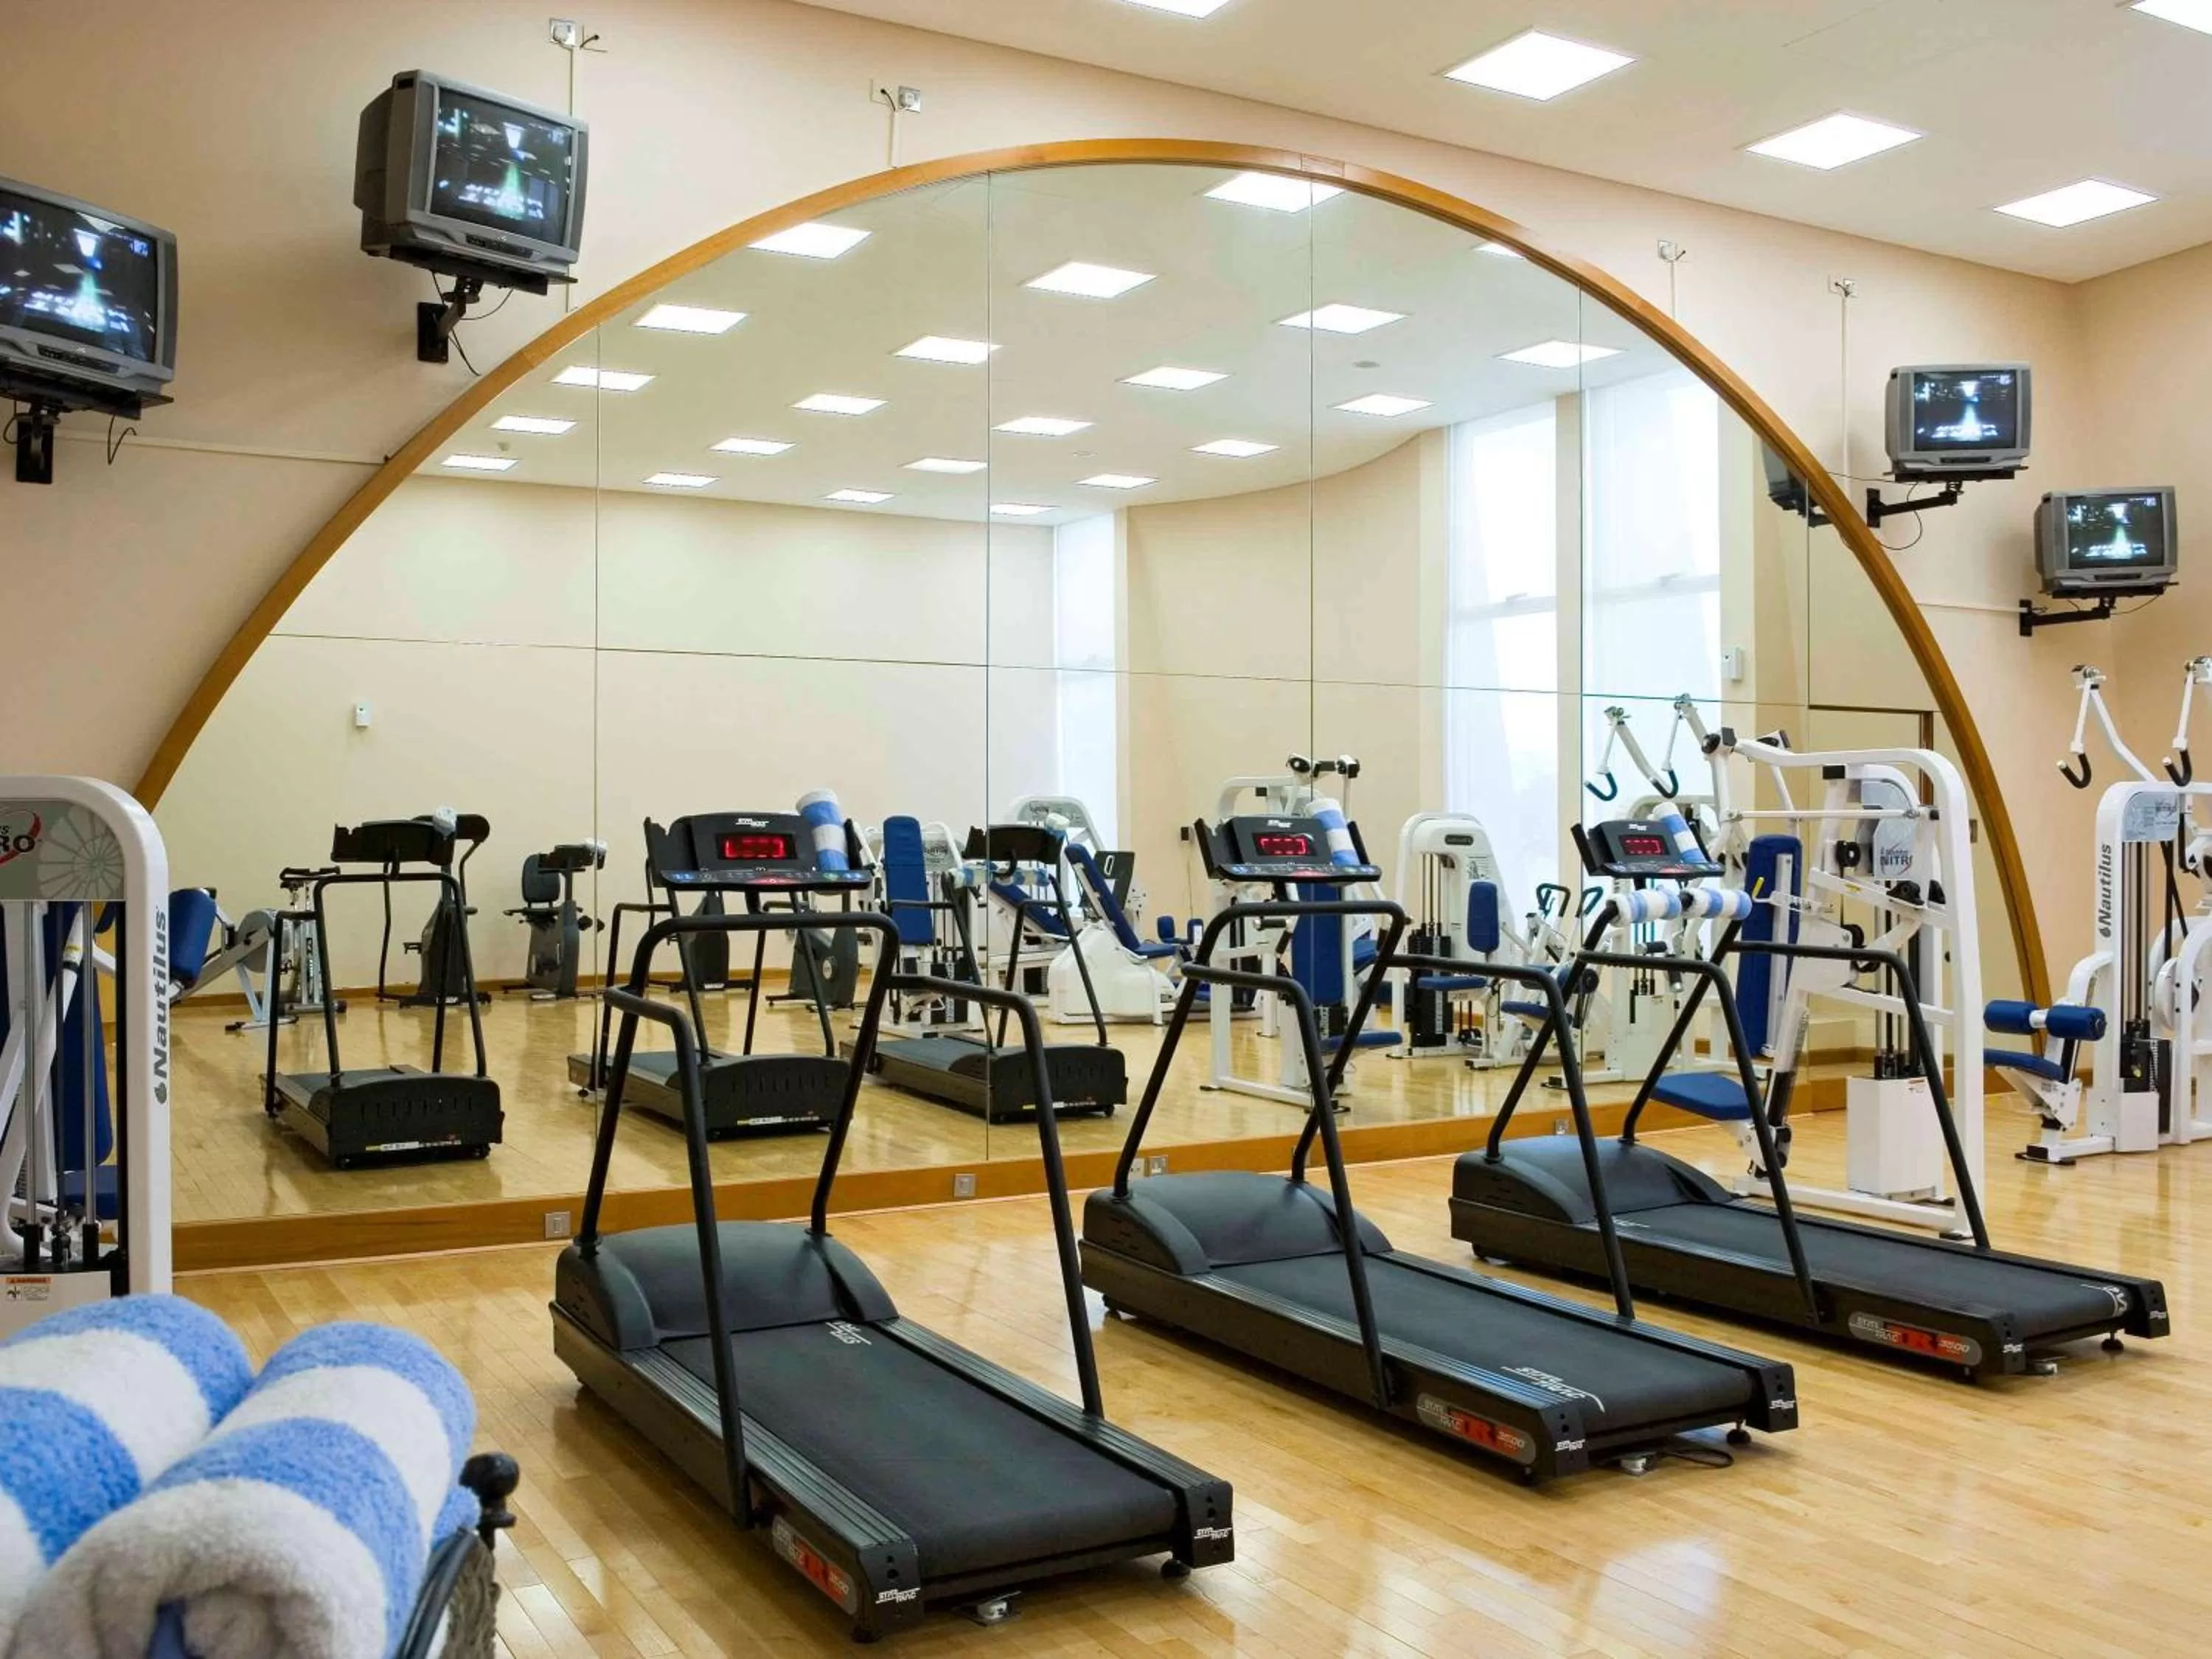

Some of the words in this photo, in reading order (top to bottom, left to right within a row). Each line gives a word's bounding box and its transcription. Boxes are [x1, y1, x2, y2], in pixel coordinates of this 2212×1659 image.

[1879, 855, 1913, 866] NITR
[2098, 844, 2112, 927] Nautilus
[153, 910, 167, 1079] Nautilus
